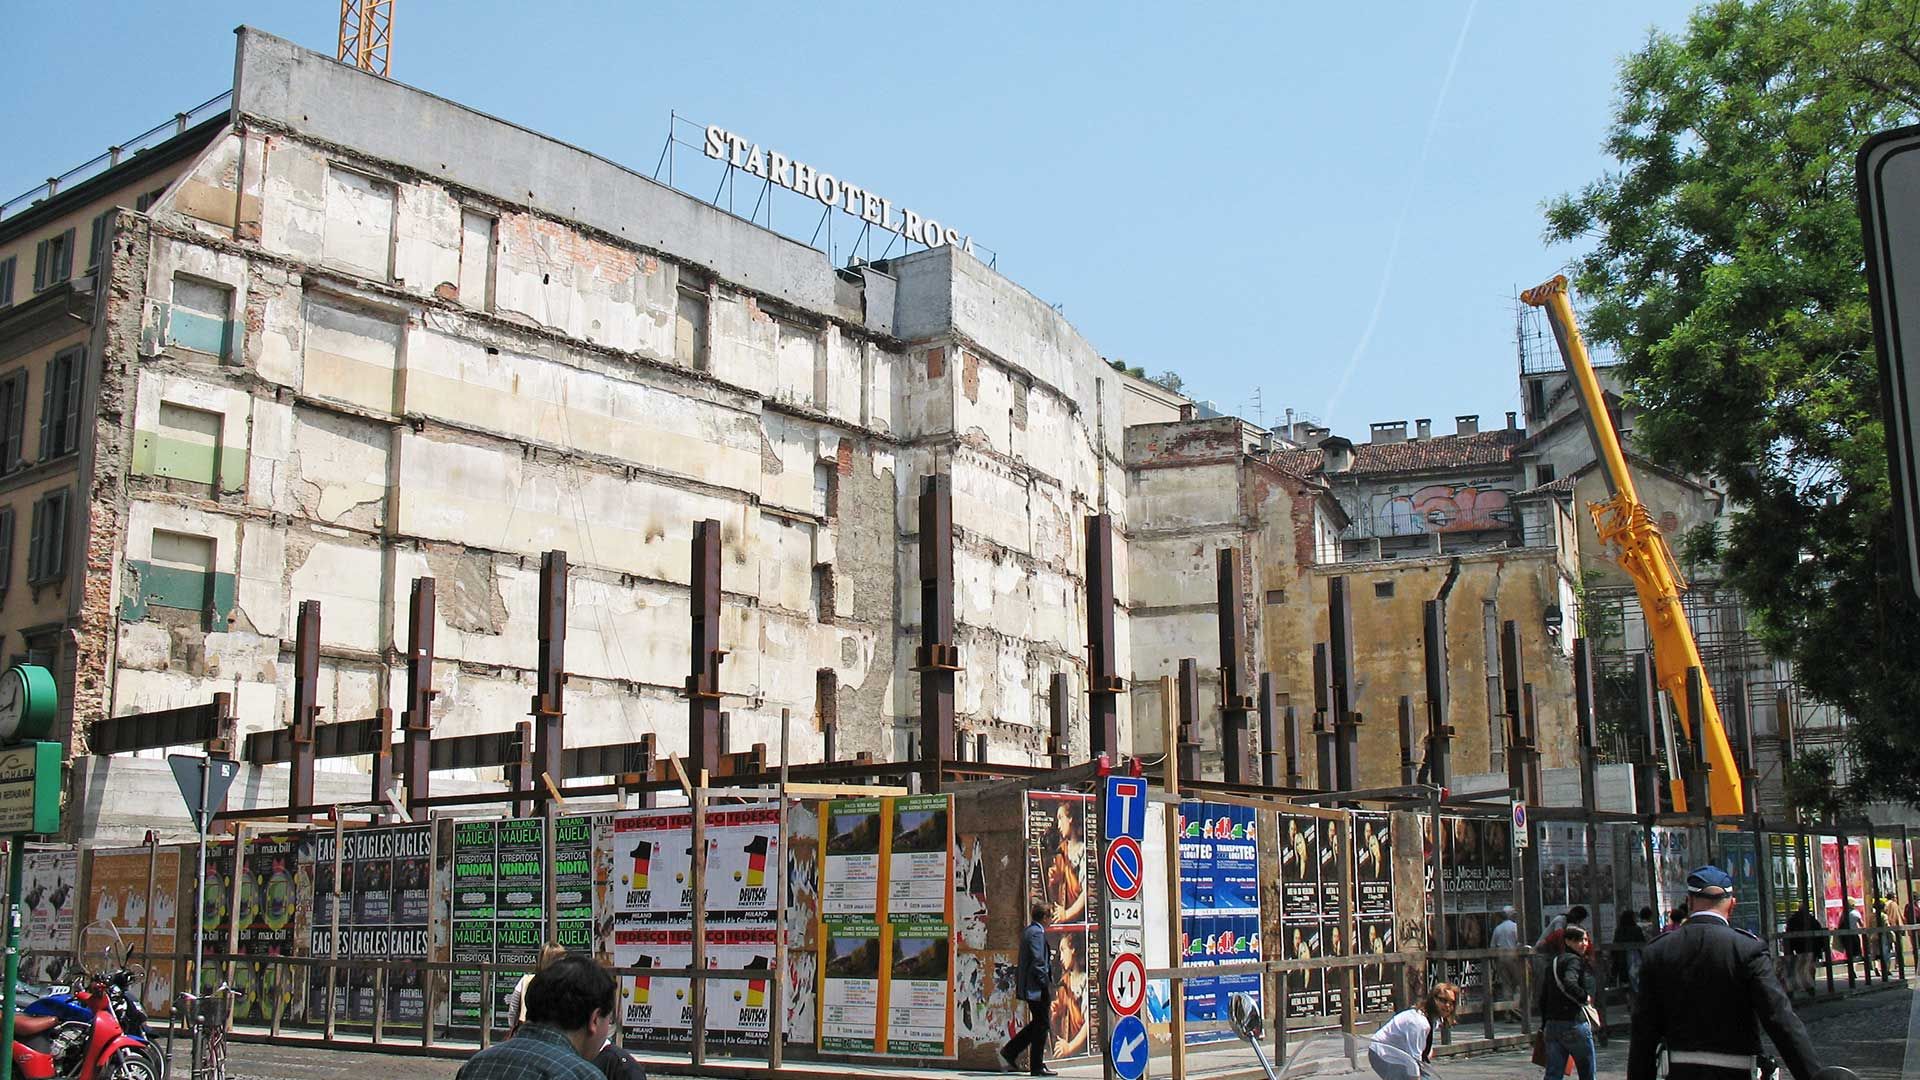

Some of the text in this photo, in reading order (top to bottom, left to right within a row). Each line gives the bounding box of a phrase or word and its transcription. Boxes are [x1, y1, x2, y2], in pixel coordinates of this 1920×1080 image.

[704, 124, 976, 256] STARHOTEL ROSA
[616, 816, 666, 828] TEDESCO
[671, 812, 723, 828] TEDCO
[456, 830, 494, 844] MAUELA
[500, 829, 541, 843] MAUELA
[556, 827, 590, 841] AUELA
[262, 842, 291, 854] max bill
[318, 837, 354, 860] EAGES
[357, 834, 392, 858] EAGLES
[394, 831, 431, 857] EAGLES
[212, 848, 221, 856] bill
[502, 853, 538, 862] STREPITOSA
[557, 852, 587, 860] REPITOSA
[1238, 846, 1255, 860] TEC
[458, 855, 492, 864] STREPITOSA
[456, 864, 494, 876] VENDITA
[500, 862, 540, 875] VENDITA
[556, 861, 589, 874] ENDITA
[1458, 865, 1482, 878] MICHELE
[1488, 865, 1510, 878] MICHELE
[1456, 877, 1484, 891] ZARRILLO
[1486, 877, 1512, 890] ZARRILLO
[403, 889, 425, 899] FAREWELL
[627, 890, 651, 903] DEUTSCH
[740, 888, 767, 902] DEUTSCH
[208, 931, 218, 939] bill
[240, 930, 251, 940] bill
[258, 929, 286, 940] max bill
[455, 930, 492, 943] MAUELA
[500, 930, 539, 944] MAUELA
[558, 930, 590, 944] AUELA
[616, 931, 666, 942] TEDESCO
[670, 931, 724, 942] TEDCO
[312, 931, 348, 954] EAGES
[352, 931, 388, 954] EAGLES
[391, 930, 428, 954] EAGLES
[456, 954, 490, 962] STREPITOSA
[500, 954, 536, 963] STREPITOSA
[400, 989, 423, 998] FAREWELL
[628, 1005, 652, 1018] DEUTSCH
[740, 1008, 767, 1022] DEUTSCH
